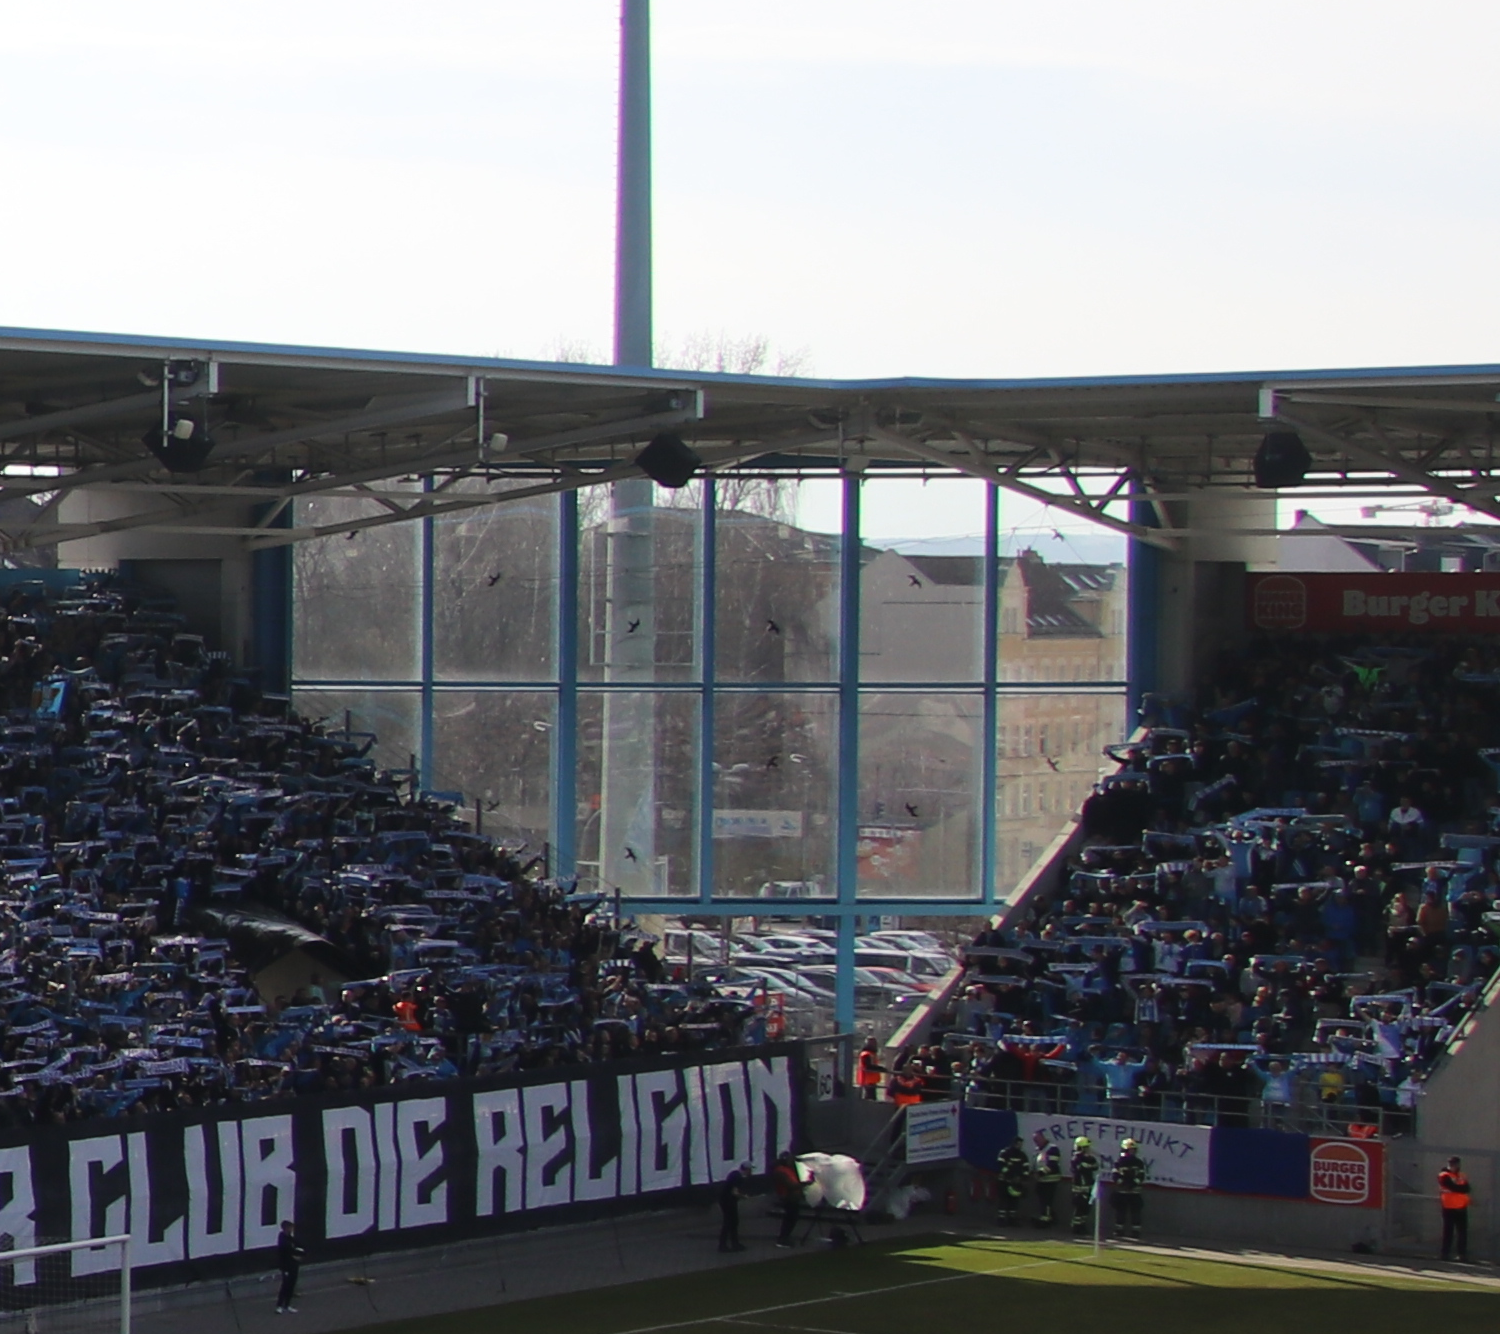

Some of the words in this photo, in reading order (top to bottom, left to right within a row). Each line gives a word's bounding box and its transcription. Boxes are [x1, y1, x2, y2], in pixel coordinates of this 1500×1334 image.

[1343, 590, 1468, 625] Burger
[1037, 1120, 1194, 1158] TREFFPUNKT
[68, 1113, 296, 1277] CLUB
[322, 1097, 448, 1239] DIE
[473, 1055, 797, 1216] RELIGION
[1313, 1160, 1366, 1175] BURGER
[1313, 1172, 1366, 1192] KING
